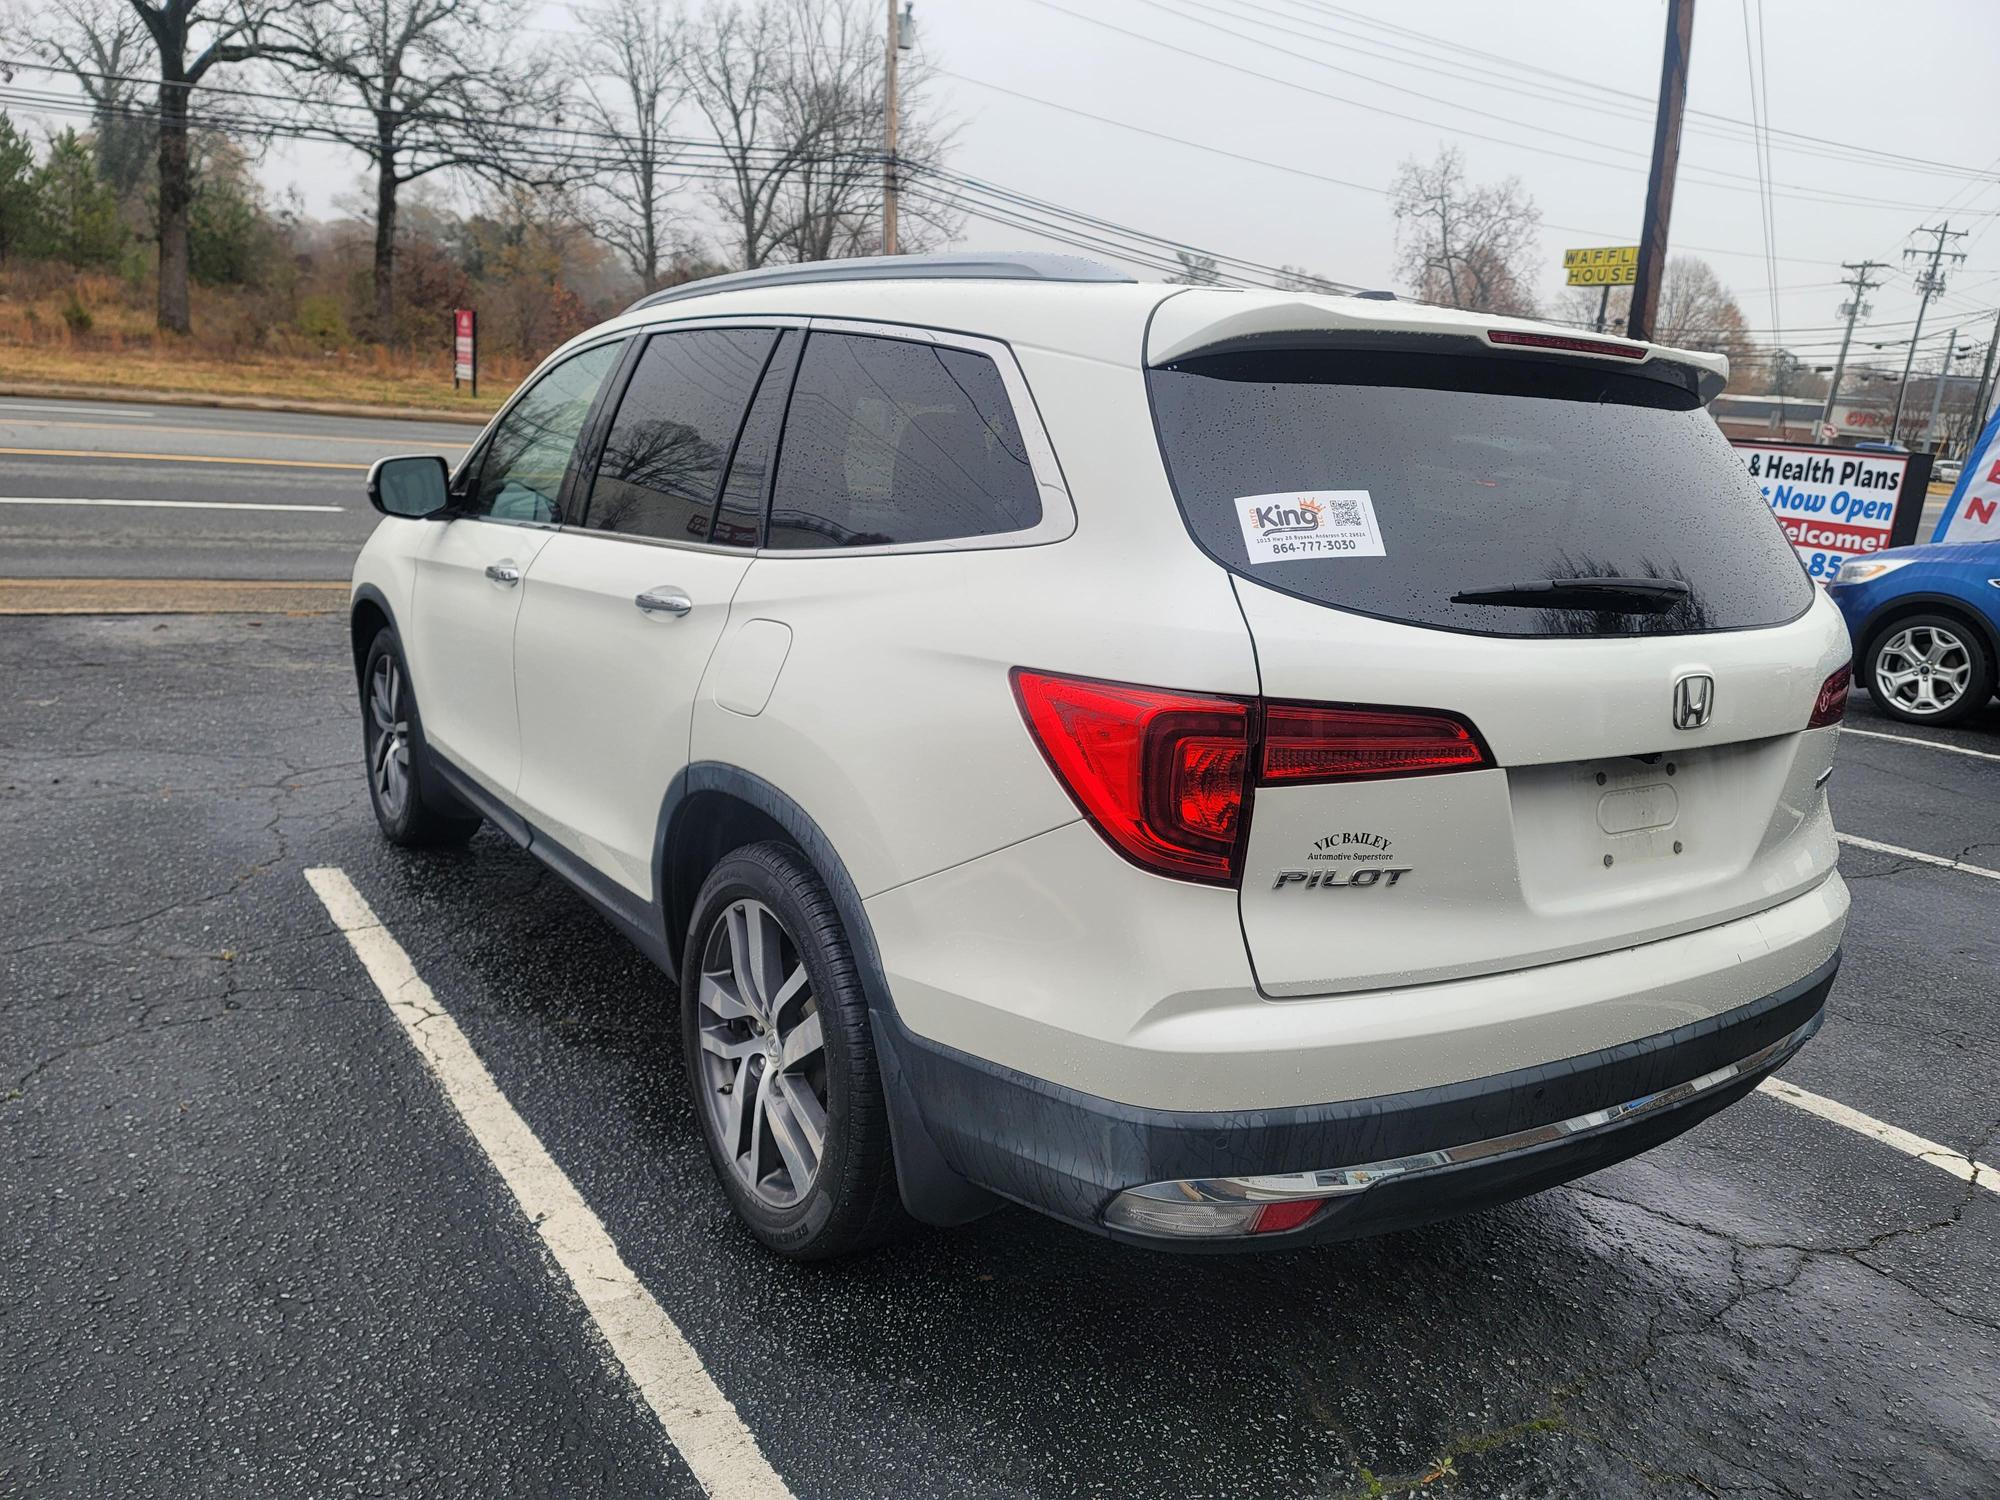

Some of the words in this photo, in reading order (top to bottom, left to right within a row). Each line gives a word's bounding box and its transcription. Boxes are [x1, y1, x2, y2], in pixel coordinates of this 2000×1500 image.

[1565, 248, 1630, 265] WAFFL
[1569, 267, 1635, 282] HOUSE
[1748, 453, 1761, 476] &
[1765, 455, 1835, 485] Health
[1839, 461, 1900, 491] Plans
[1772, 484, 1826, 513] Now
[1830, 491, 1893, 523] Open
[1255, 504, 1319, 536] King
[1272, 540, 1356, 554] 864-777-3030
[1313, 834, 1340, 851] VIC
[1341, 832, 1392, 851] BAILEY
[1307, 852, 1352, 861] Automotive
[1352, 852, 1394, 862] Superstore
[1272, 865, 1414, 890] PILOT
